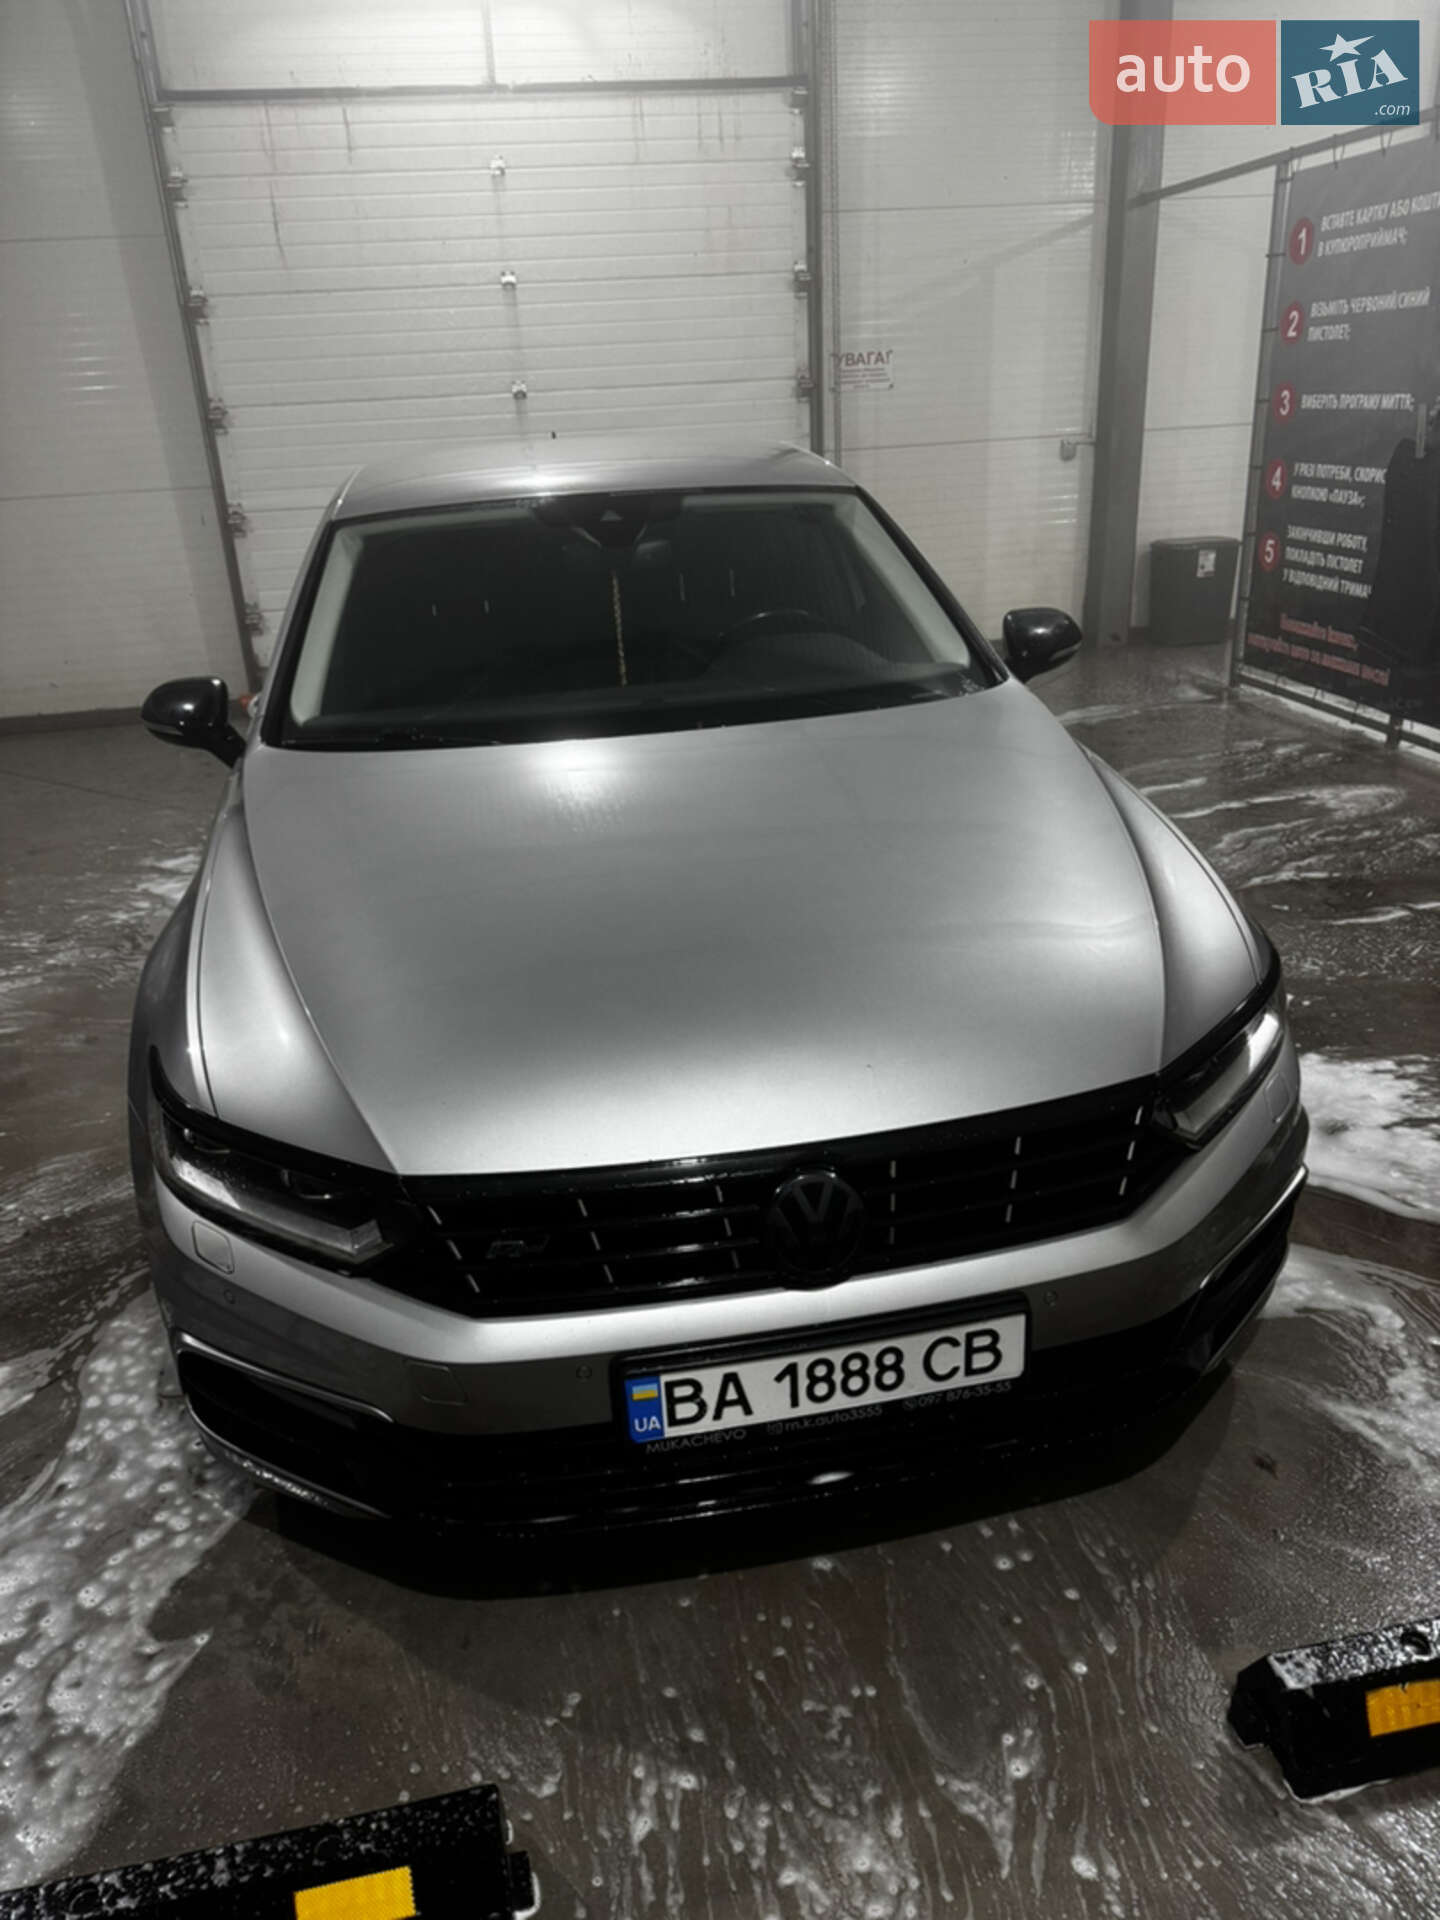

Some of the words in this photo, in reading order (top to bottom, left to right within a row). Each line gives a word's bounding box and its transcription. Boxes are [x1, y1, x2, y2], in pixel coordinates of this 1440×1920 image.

[1389, 198, 1410, 219] АБО
[1297, 227, 1308, 256] 1
[1287, 310, 1298, 337] 2
[1280, 390, 1291, 415] 3
[1271, 465, 1282, 491] 4
[1264, 539, 1275, 563] 5
[664, 1371, 754, 1428] BA
[774, 1345, 905, 1409] 1888
[923, 1327, 1003, 1382] CB
[633, 1414, 662, 1433] UA
[645, 1428, 747, 1454] MUKACHEVO
